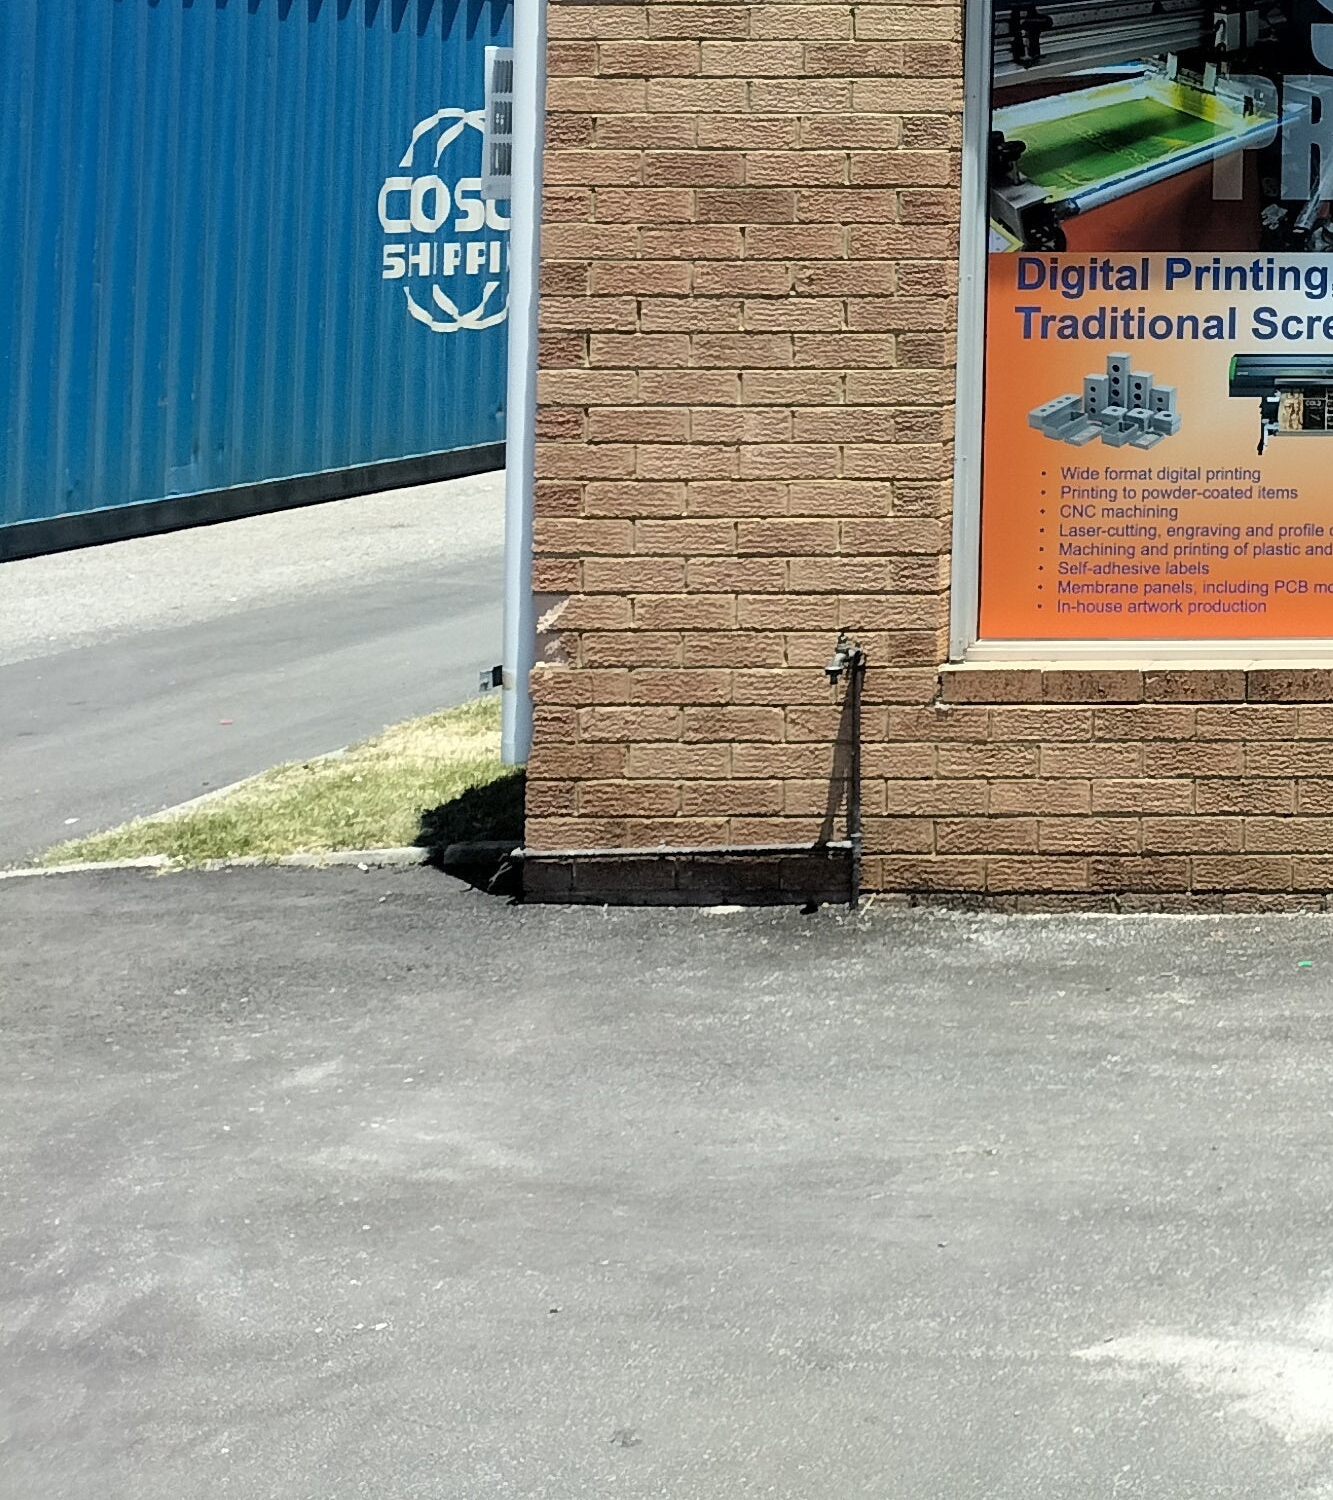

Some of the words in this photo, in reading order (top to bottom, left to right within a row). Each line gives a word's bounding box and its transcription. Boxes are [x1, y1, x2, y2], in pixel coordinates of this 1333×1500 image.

[382, 241, 512, 279] SHIPPI
[1016, 257, 1150, 298] Digital
[1015, 307, 1236, 340] Traditional
[1061, 467, 1099, 480] Wide
[1105, 467, 1152, 480] format
[1157, 467, 1201, 483] digital
[1206, 467, 1260, 483] printing
[1061, 486, 1117, 503] Printing
[1123, 486, 1136, 500] to
[1142, 485, 1252, 503] powder-coated
[1258, 485, 1298, 499] items
[1060, 504, 1096, 518] CNC
[1102, 505, 1178, 521] machining
[1060, 524, 1161, 540] Laser-cutting,
[1167, 524, 1240, 540] engraving
[1246, 524, 1273, 537] and
[1279, 523, 1324, 540] profile
[1059, 543, 1135, 559] Machining
[1141, 543, 1168, 555] and
[1174, 543, 1229, 559] printing
[1234, 542, 1249, 555] of
[1253, 543, 1301, 559] plastic
[1305, 543, 1332, 555] and
[1058, 561, 1160, 574] Self-adhesive
[1166, 561, 1209, 574] labels
[1058, 580, 1138, 594] Membrane
[1144, 580, 1196, 597] panels,
[1203, 580, 1268, 596] including
[1275, 580, 1309, 593] PCB
[1058, 599, 1122, 613] In-house
[1128, 598, 1183, 613] artwork
[1188, 599, 1266, 615] production
